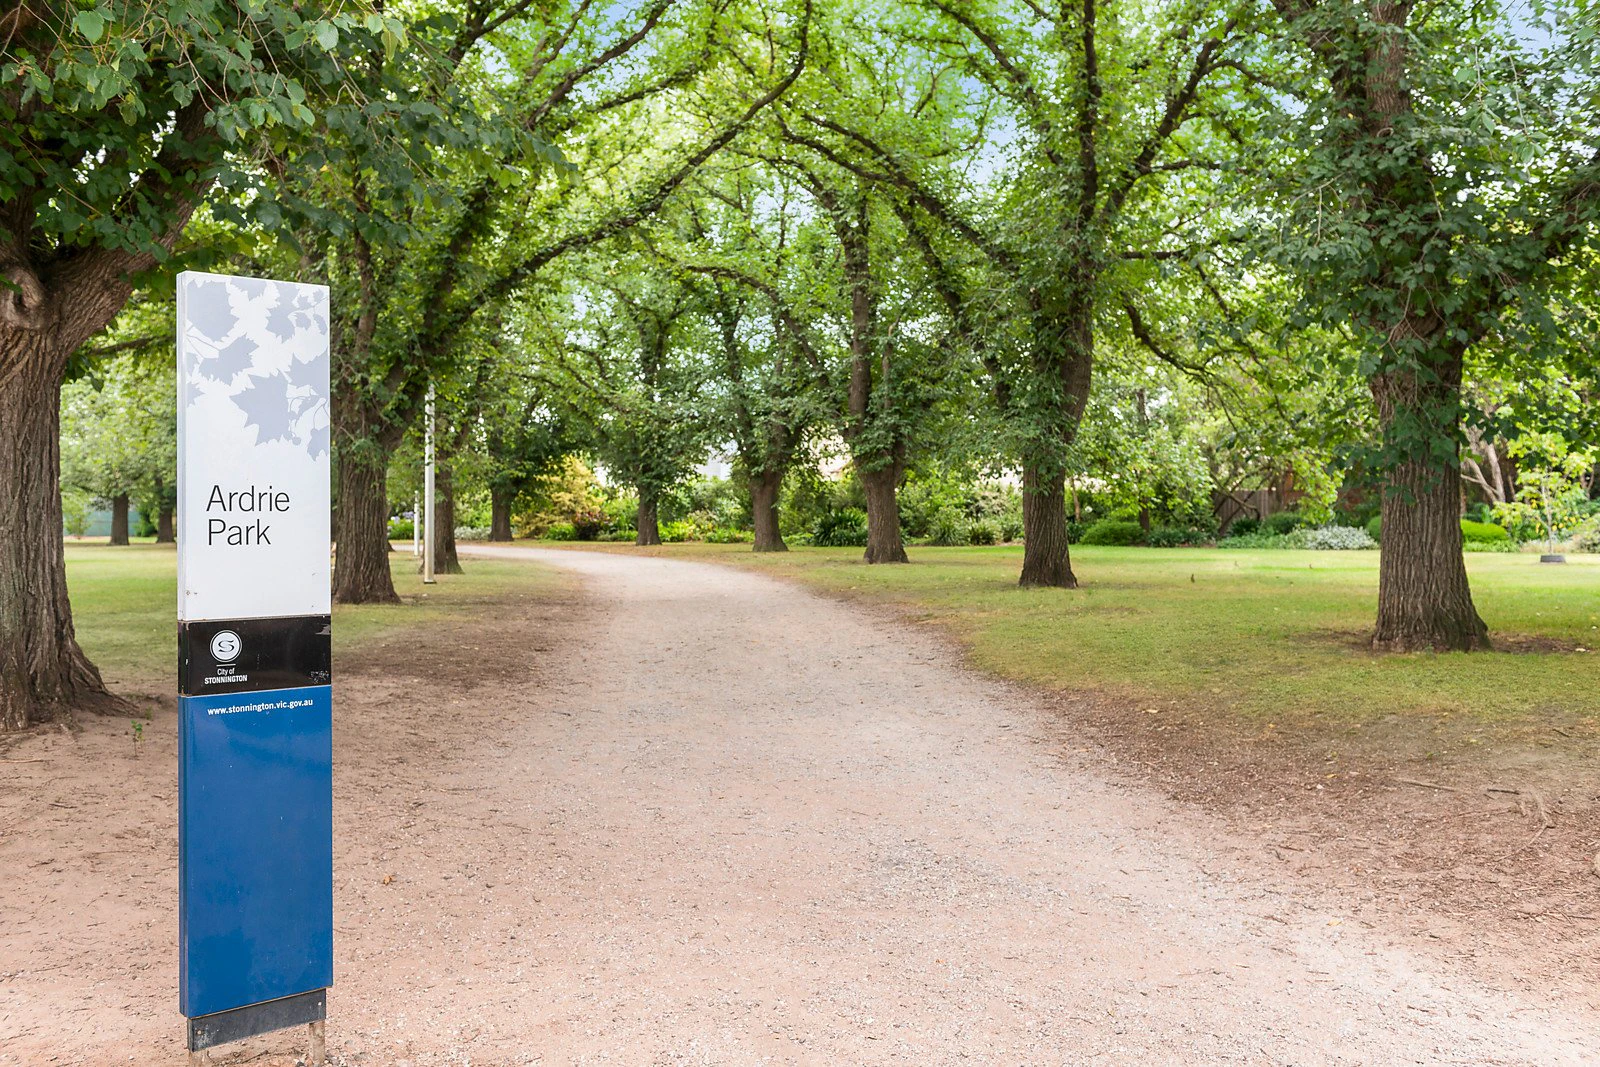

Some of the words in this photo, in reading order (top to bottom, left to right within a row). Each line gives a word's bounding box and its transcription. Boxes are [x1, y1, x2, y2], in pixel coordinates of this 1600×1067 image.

[206, 485, 290, 512] Ardrie
[208, 519, 271, 546] Park
[218, 640, 234, 652] S
[217, 668, 229, 676] City
[204, 675, 248, 685] STONNINGTON
[207, 699, 313, 716] www.stonnington.vic.gov.au
